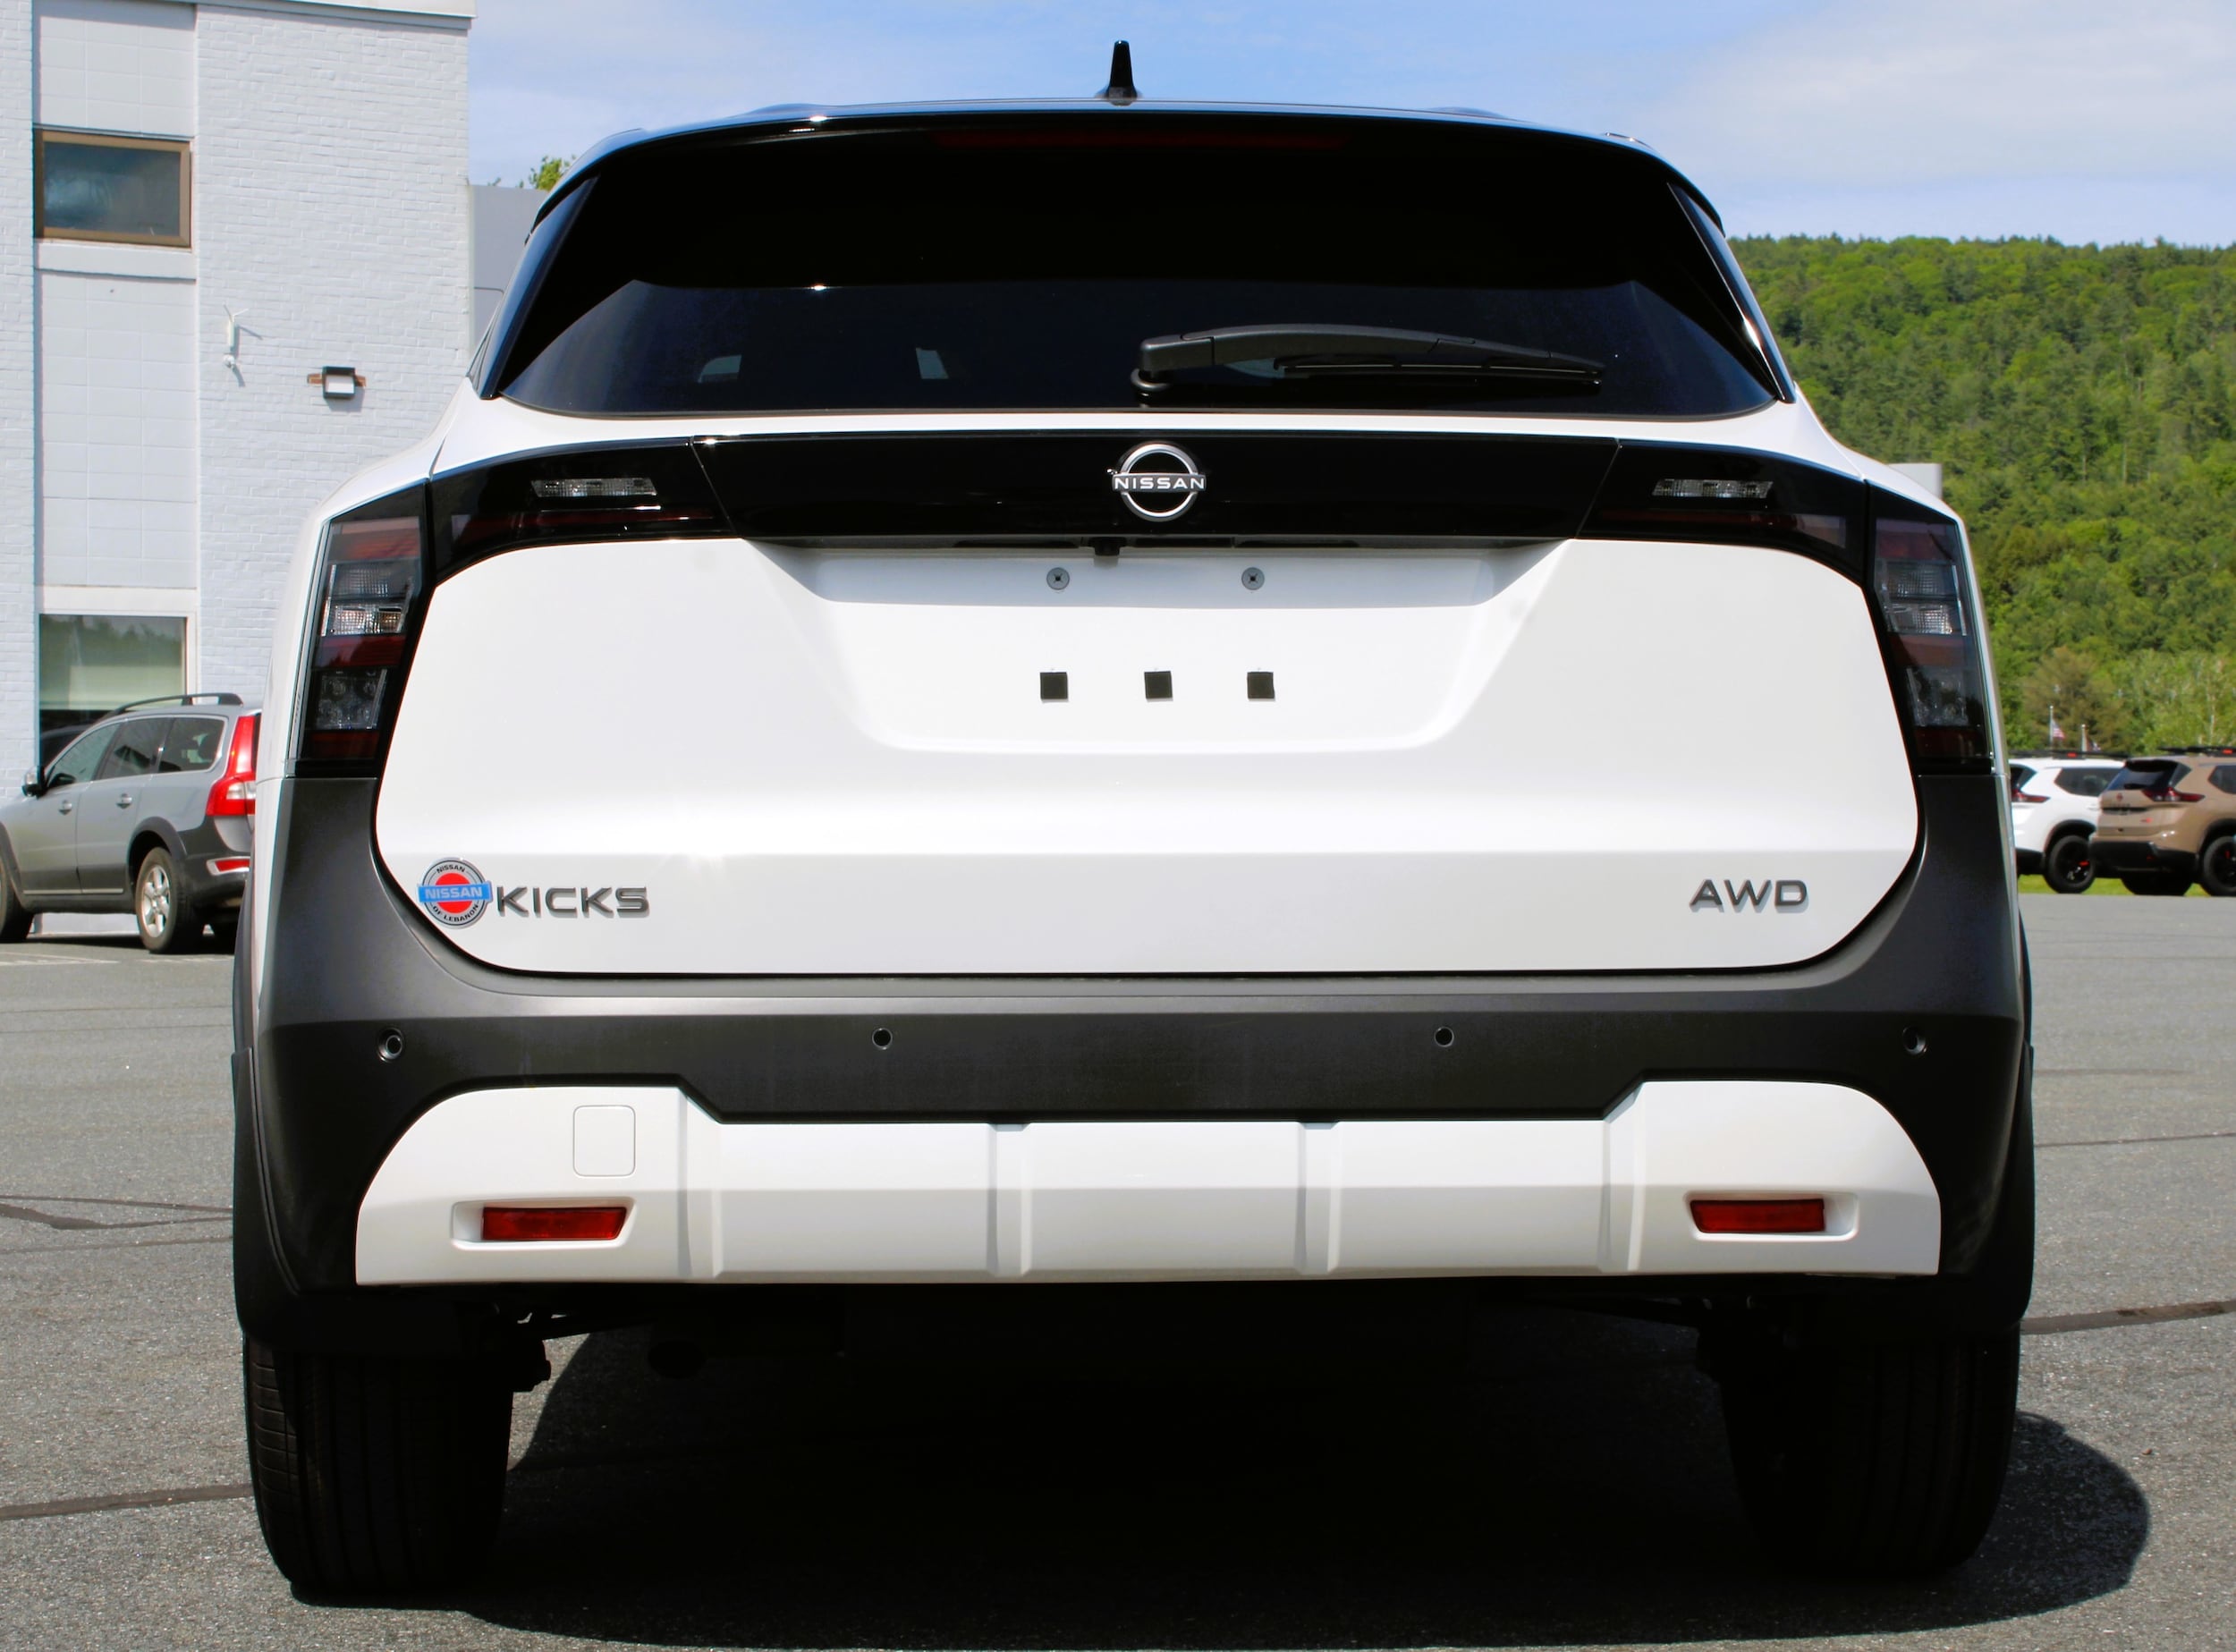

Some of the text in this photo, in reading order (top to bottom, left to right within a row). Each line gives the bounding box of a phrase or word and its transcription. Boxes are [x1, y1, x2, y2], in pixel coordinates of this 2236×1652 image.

[1114, 478, 1205, 490] NISSAN
[436, 864, 466, 874] NISSAN
[425, 886, 483, 899] NISSAN
[496, 885, 649, 914] KICKS
[1689, 878, 1808, 907] AWD
[433, 904, 479, 922] OF LEBANON
